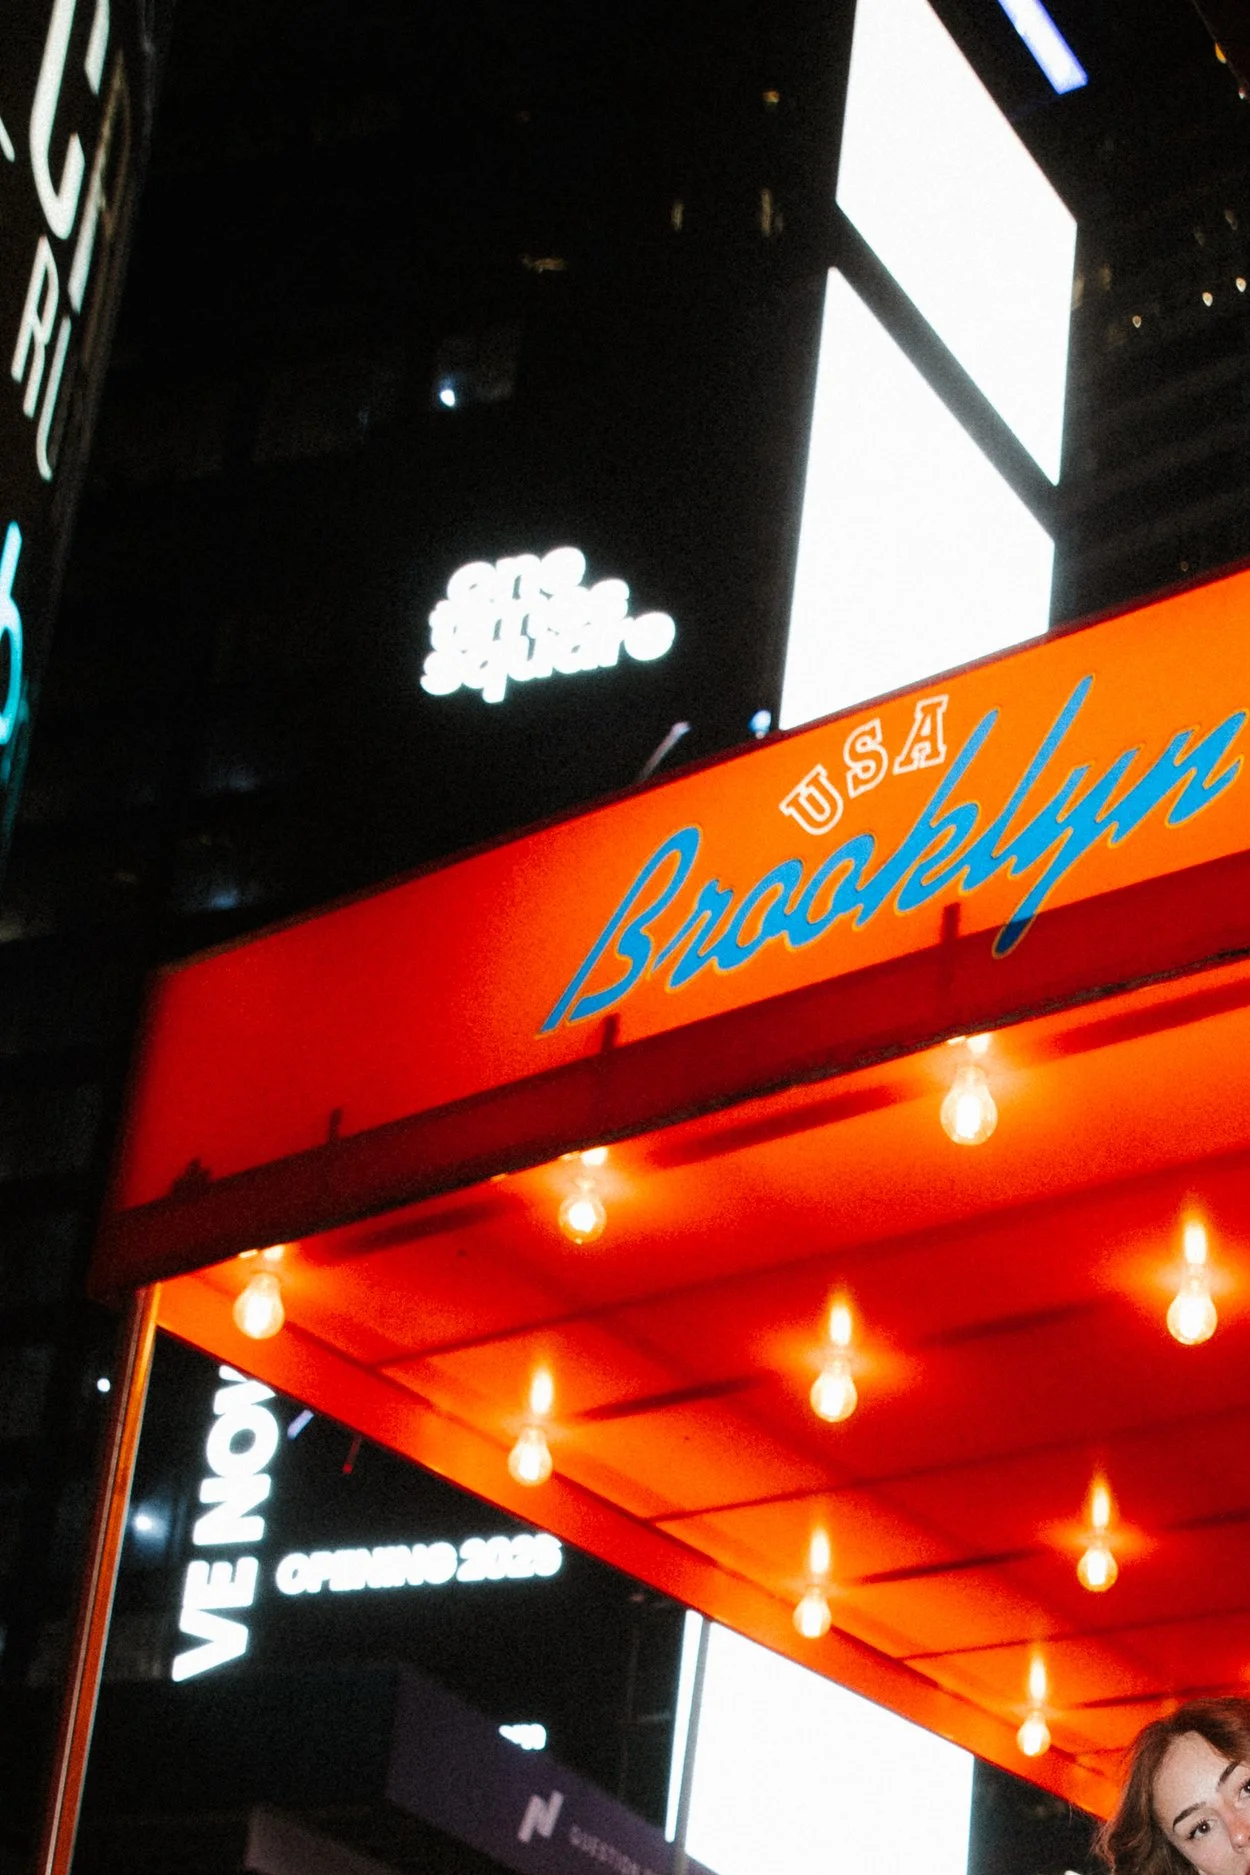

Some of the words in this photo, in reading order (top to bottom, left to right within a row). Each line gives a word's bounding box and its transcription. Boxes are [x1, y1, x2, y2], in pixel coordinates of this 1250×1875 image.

[779, 694, 949, 836] USA
[537, 674, 1250, 1036] Brooklyn
[276, 1542, 458, 1595] OPENING
